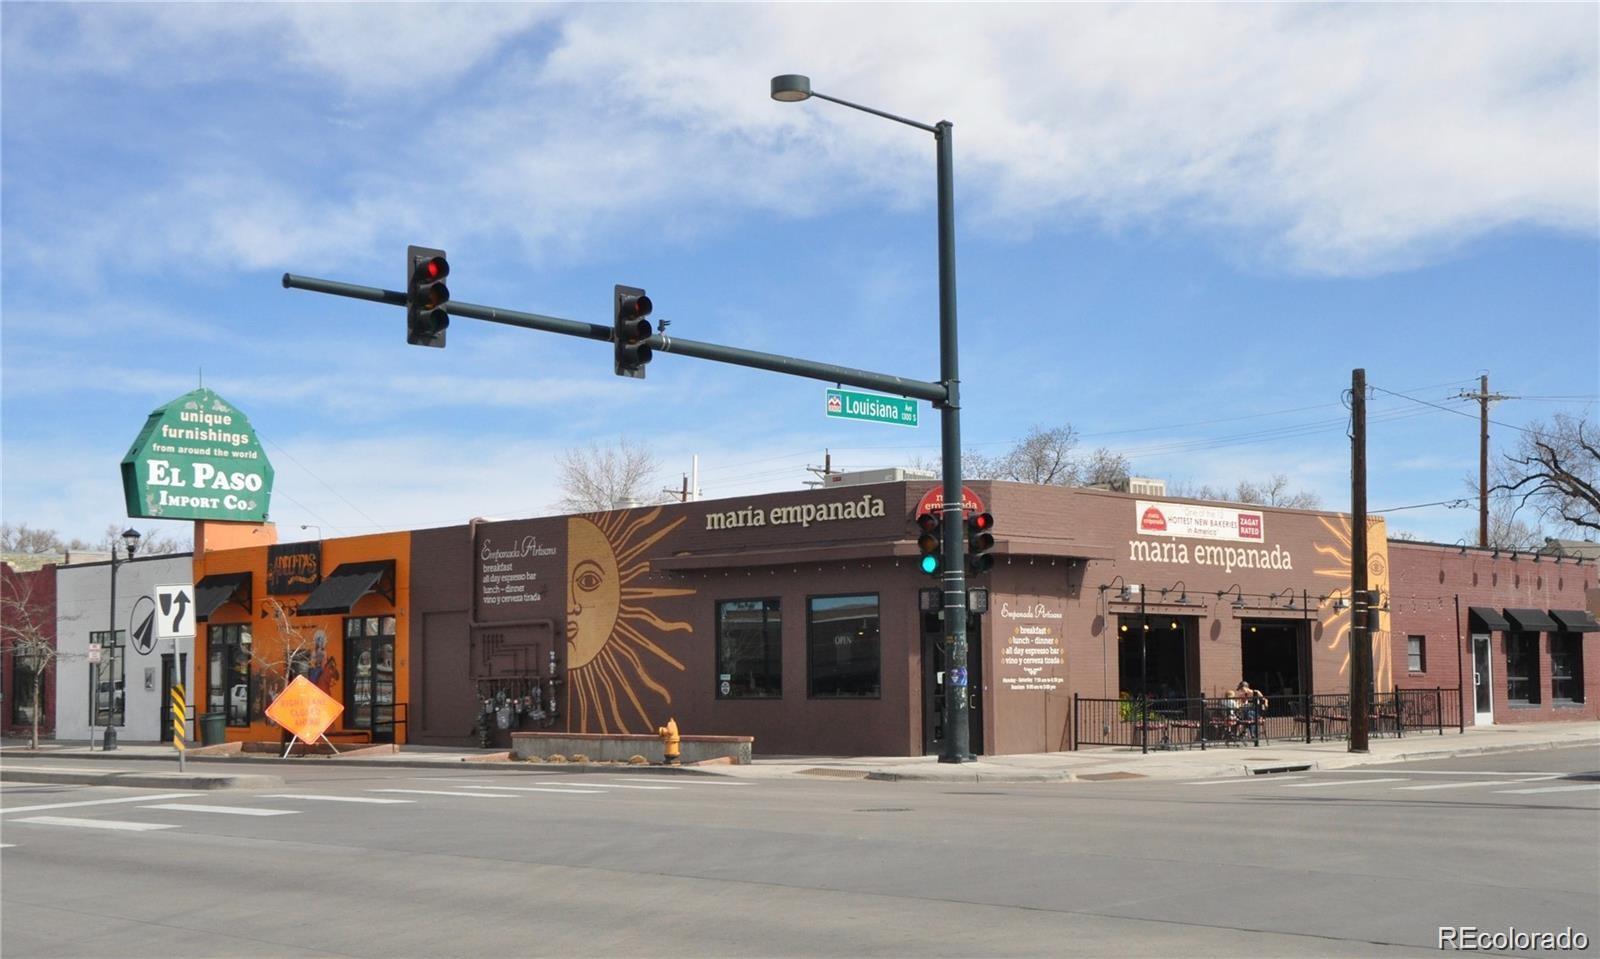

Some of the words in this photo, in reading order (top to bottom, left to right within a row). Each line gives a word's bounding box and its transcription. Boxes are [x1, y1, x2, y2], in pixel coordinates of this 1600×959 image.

[846, 396, 898, 419] Louisiana
[904, 404, 912, 412] Ave
[180, 410, 232, 426] unique
[162, 424, 249, 446] furnishings
[152, 443, 175, 453] from
[178, 446, 211, 456] around
[213, 447, 229, 457] the
[231, 449, 257, 459] world
[706, 506, 766, 530] maria
[770, 495, 885, 528] empanada
[1168, 515, 1193, 525] HOTTEST
[1194, 518, 1208, 527] NEW
[1210, 519, 1237, 529] BAKERIES
[1240, 517, 1259, 526] ZAGAT
[1241, 527, 1260, 535] RATED
[481, 538, 520, 562] Empanada
[1129, 537, 1189, 564] maria
[1194, 544, 1293, 573] empanada
[483, 563, 513, 573] breakfast
[490, 574, 500, 584] day
[526, 572, 536, 581] bar
[483, 585, 500, 594] lunch
[505, 585, 525, 593] dinner
[1001, 602, 1034, 620] Empanada
[1020, 626, 1047, 635] breakfast
[1012, 636, 1030, 645] lunch
[1035, 636, 1054, 645] dinner
[1013, 647, 1025, 656] day
[1050, 647, 1060, 655] bar
